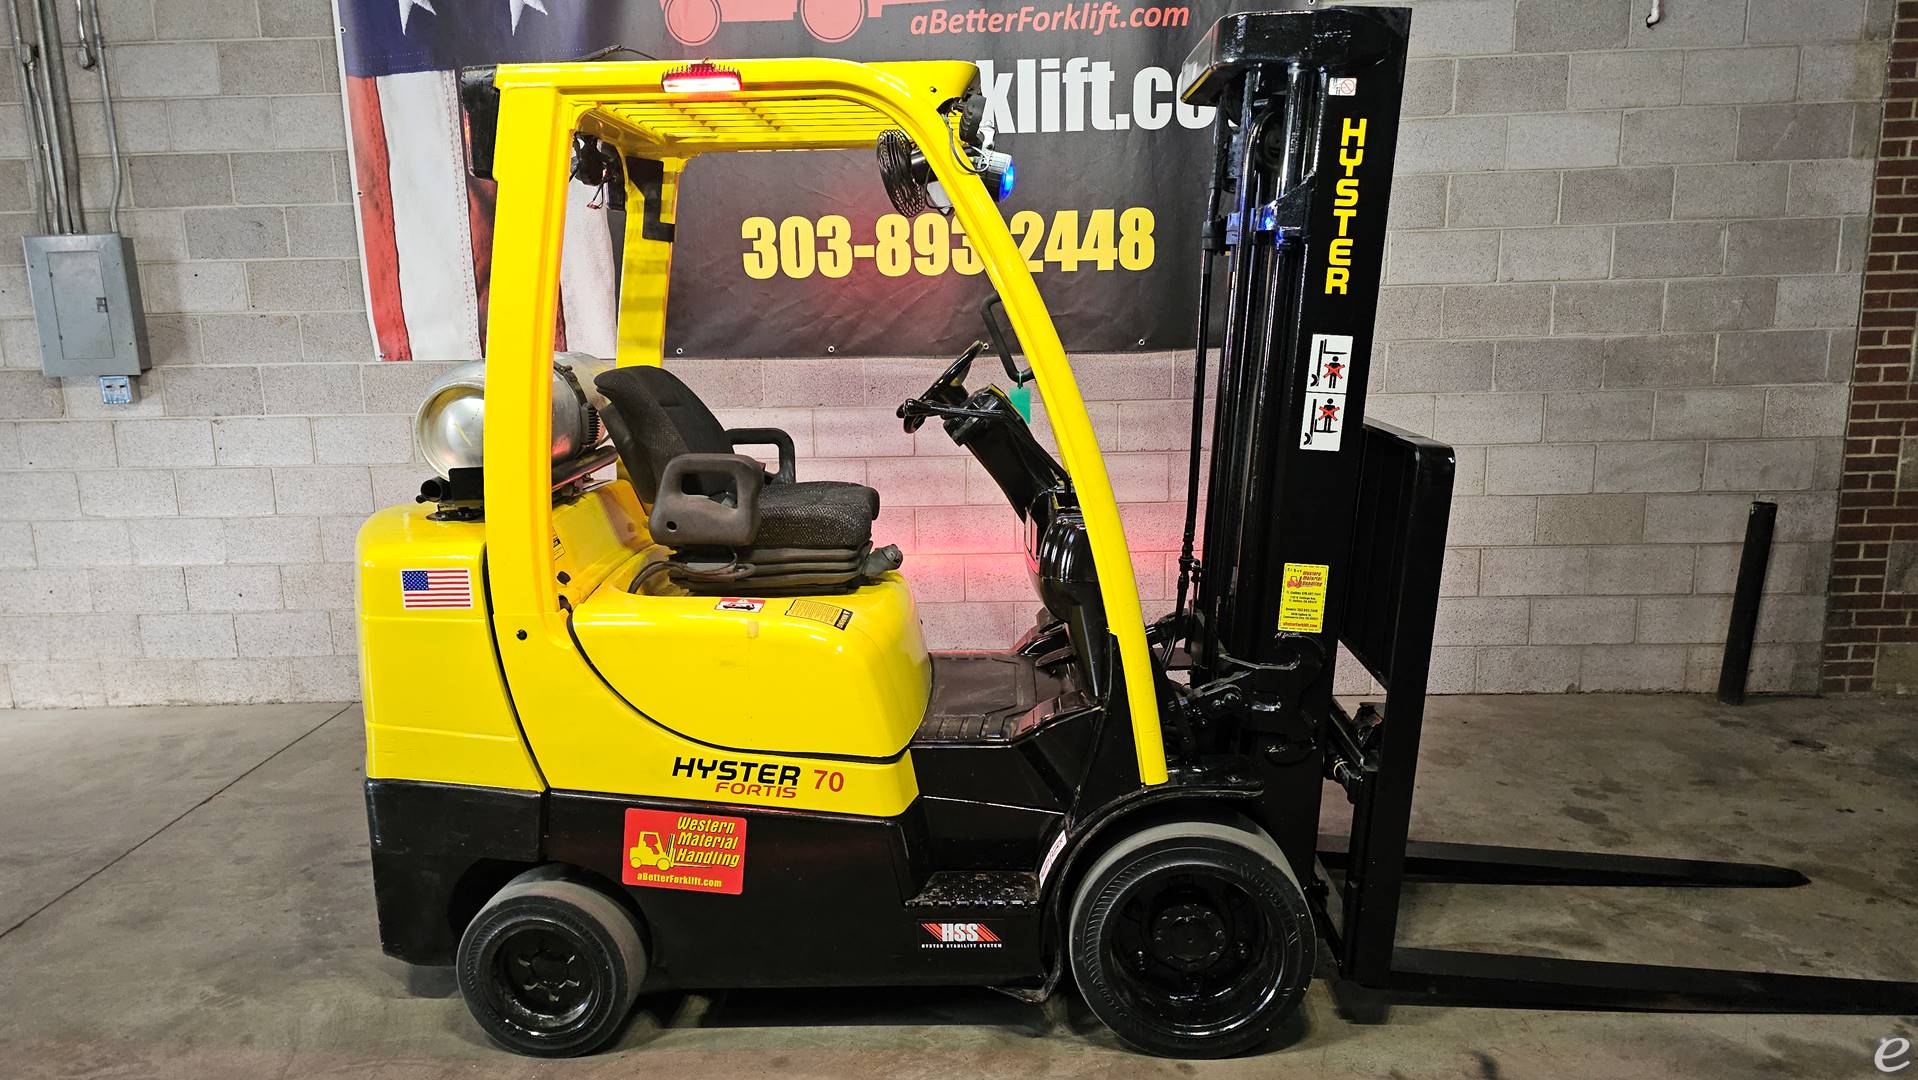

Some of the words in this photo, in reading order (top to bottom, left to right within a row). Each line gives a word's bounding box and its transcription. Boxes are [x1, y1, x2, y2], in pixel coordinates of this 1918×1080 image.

[910, 1, 1190, 36] aBetterForklift.com
[1325, 118, 1367, 295] HYSTER
[672, 757, 801, 786] HYSTER
[814, 769, 844, 792] 70
[715, 782, 797, 798] FORTIS
[677, 816, 736, 834] Western
[677, 831, 739, 850] Material
[676, 848, 741, 868] Handling
[637, 872, 722, 887] aBetterForklift.com
[941, 923, 979, 942] HSS
